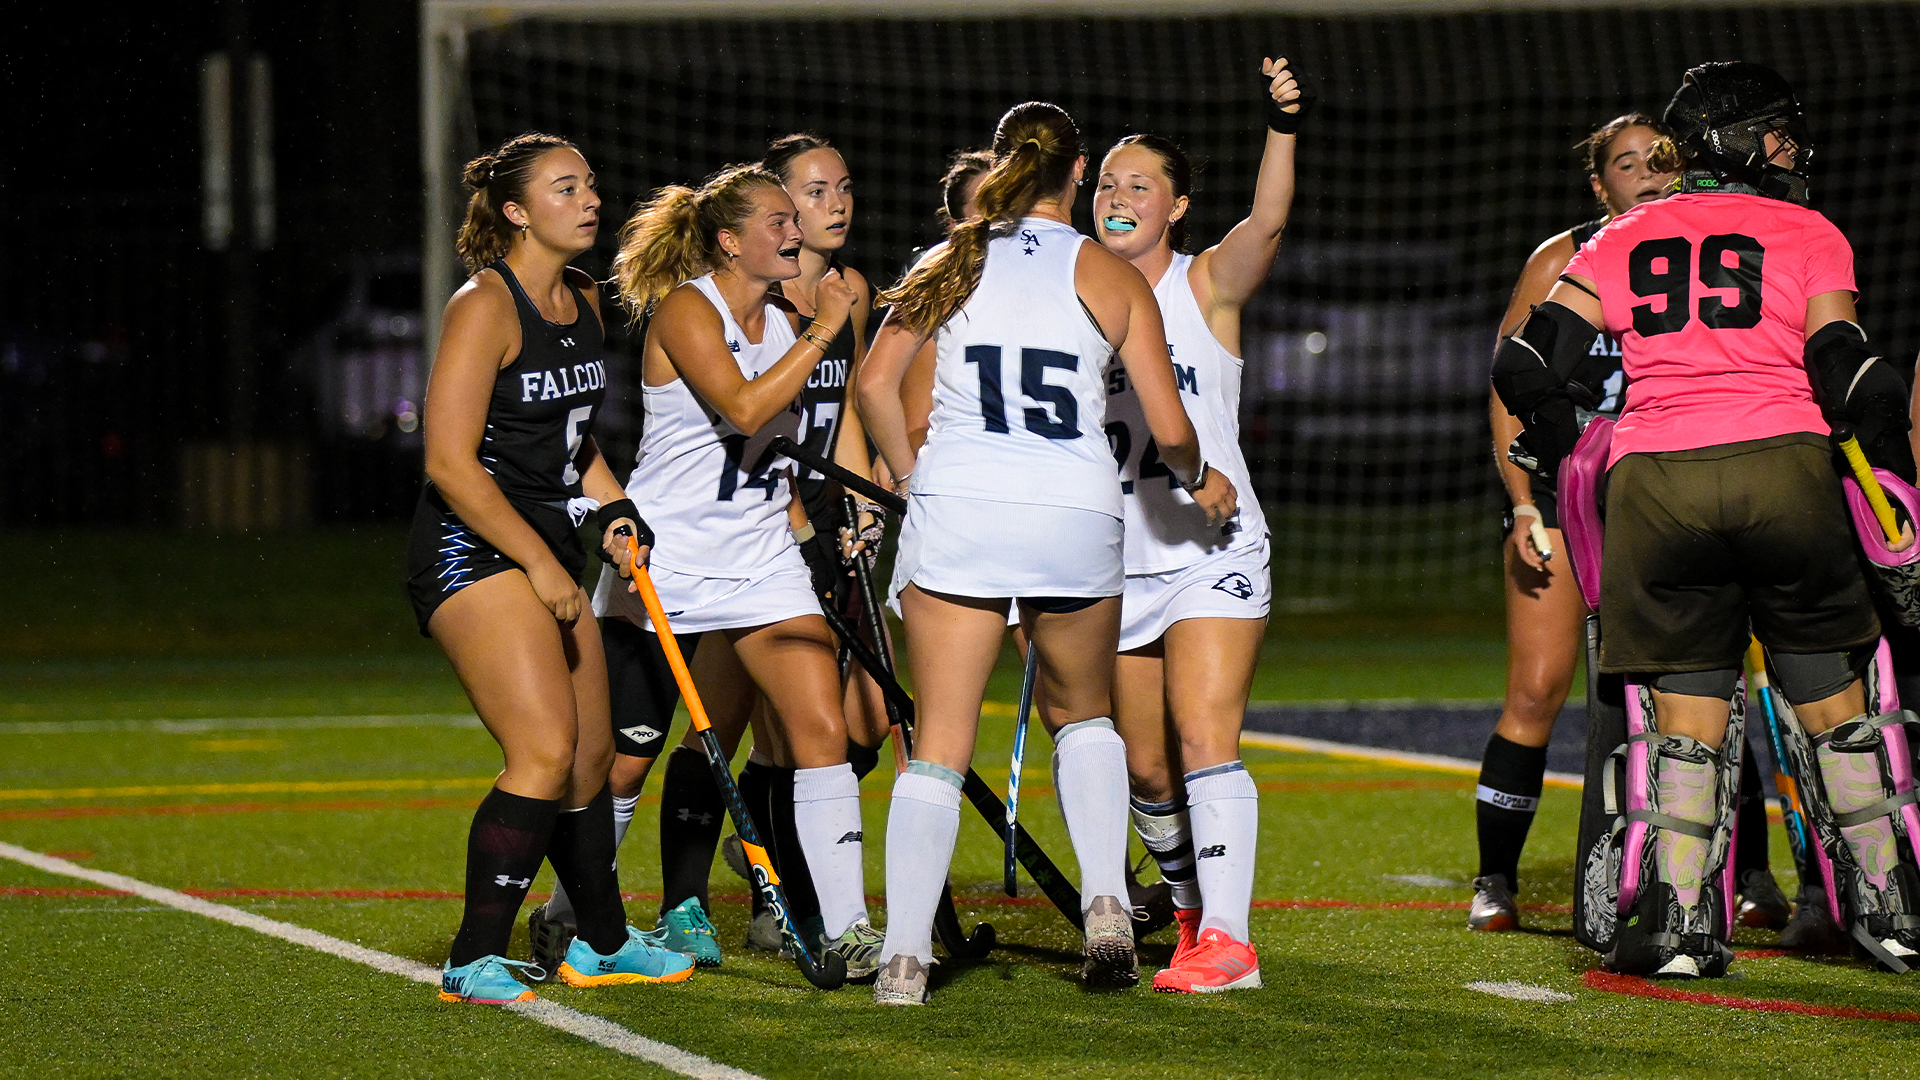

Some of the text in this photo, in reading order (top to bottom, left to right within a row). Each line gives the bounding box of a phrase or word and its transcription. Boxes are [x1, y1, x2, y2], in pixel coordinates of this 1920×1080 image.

[1020, 229, 1042, 246] SA
[1628, 233, 1766, 338] 99
[521, 359, 607, 402] FALCON
[802, 359, 849, 389] CON
[964, 343, 1083, 440] 15
[562, 404, 593, 487] 5
[716, 433, 783, 502] 14
[631, 730, 654, 738] PRO
[443, 974, 466, 992] SAK
